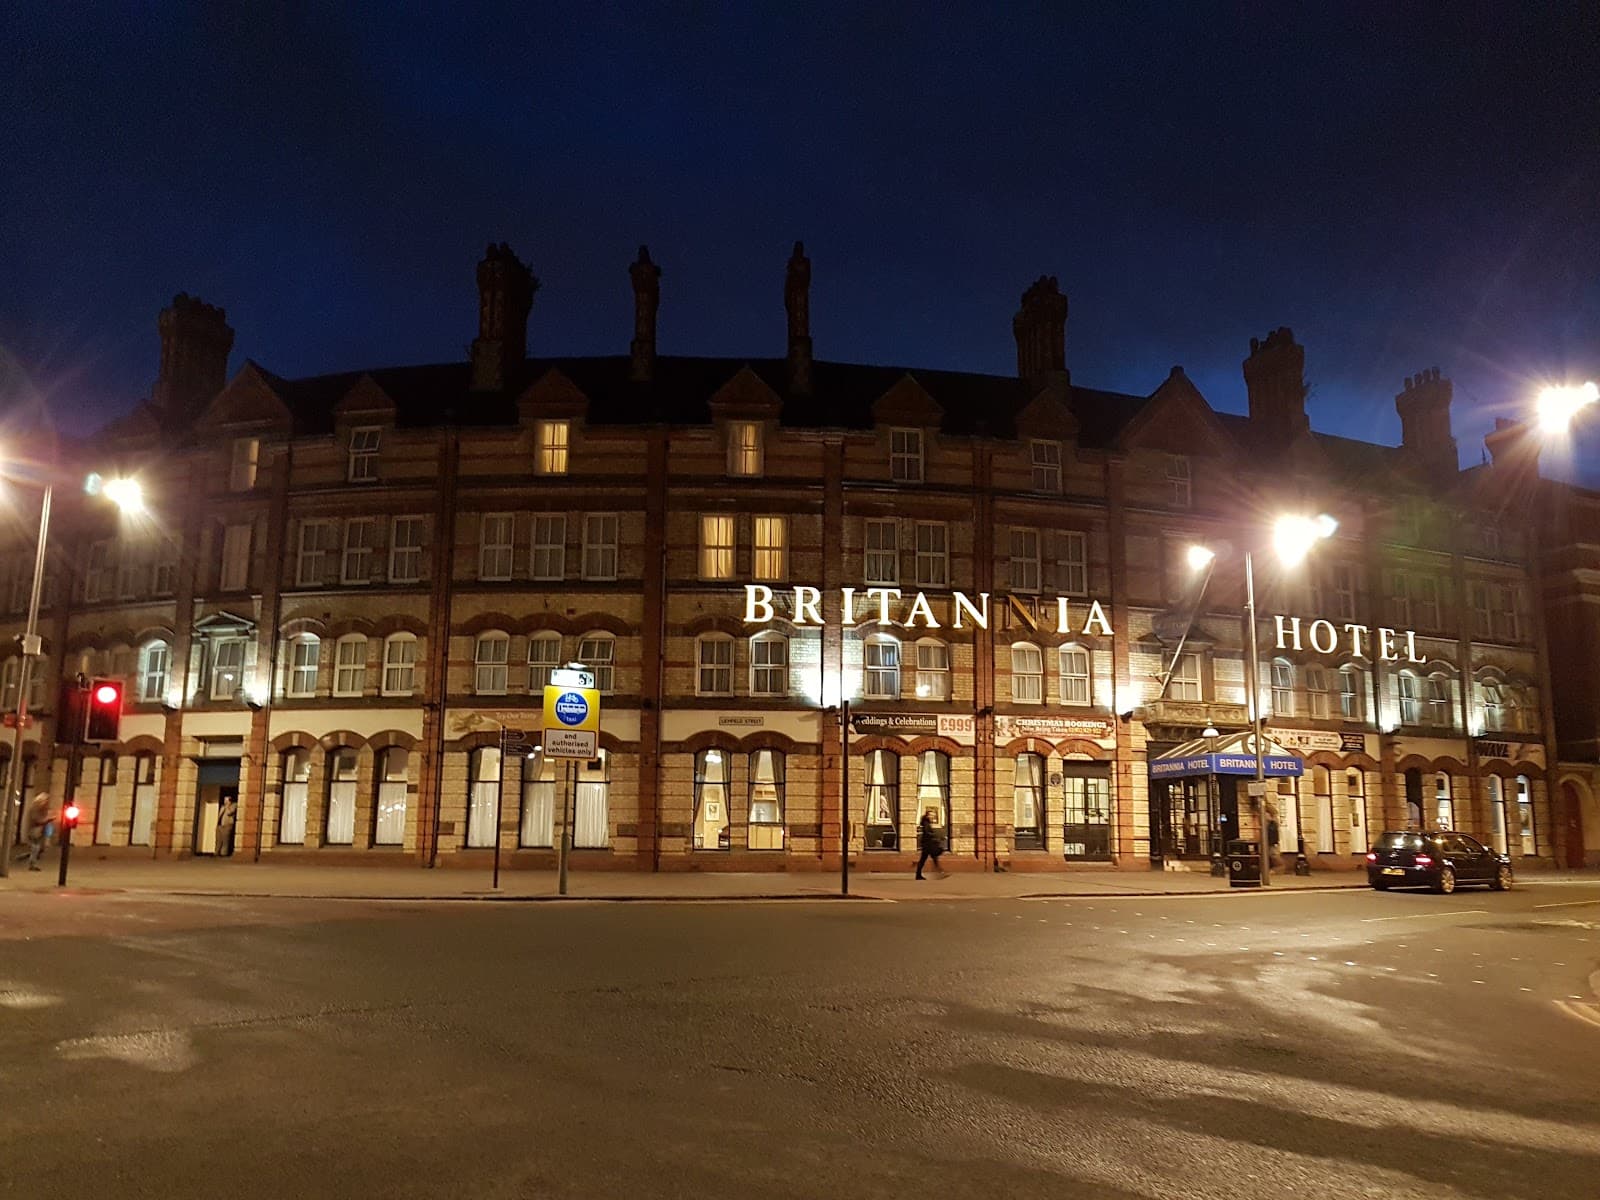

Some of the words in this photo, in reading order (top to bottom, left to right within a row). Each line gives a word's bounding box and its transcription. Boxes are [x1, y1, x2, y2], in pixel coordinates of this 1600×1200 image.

[744, 585, 1114, 635] BRITANNIA
[1274, 615, 1426, 663] HOTEL
[888, 717, 894, 726] &
[894, 717, 937, 726] Celebrations
[940, 718, 972, 732] £999
[1015, 719, 1063, 727] CHRISTMAS
[1064, 720, 1107, 729] BOOKINGS
[552, 740, 589, 748] authorised
[577, 748, 592, 756] only
[1152, 762, 1185, 774] BRITANNIA
[1187, 759, 1210, 770] HOTEL
[1219, 758, 1265, 770] BRITANN
[1270, 760, 1298, 770] HOTEL
